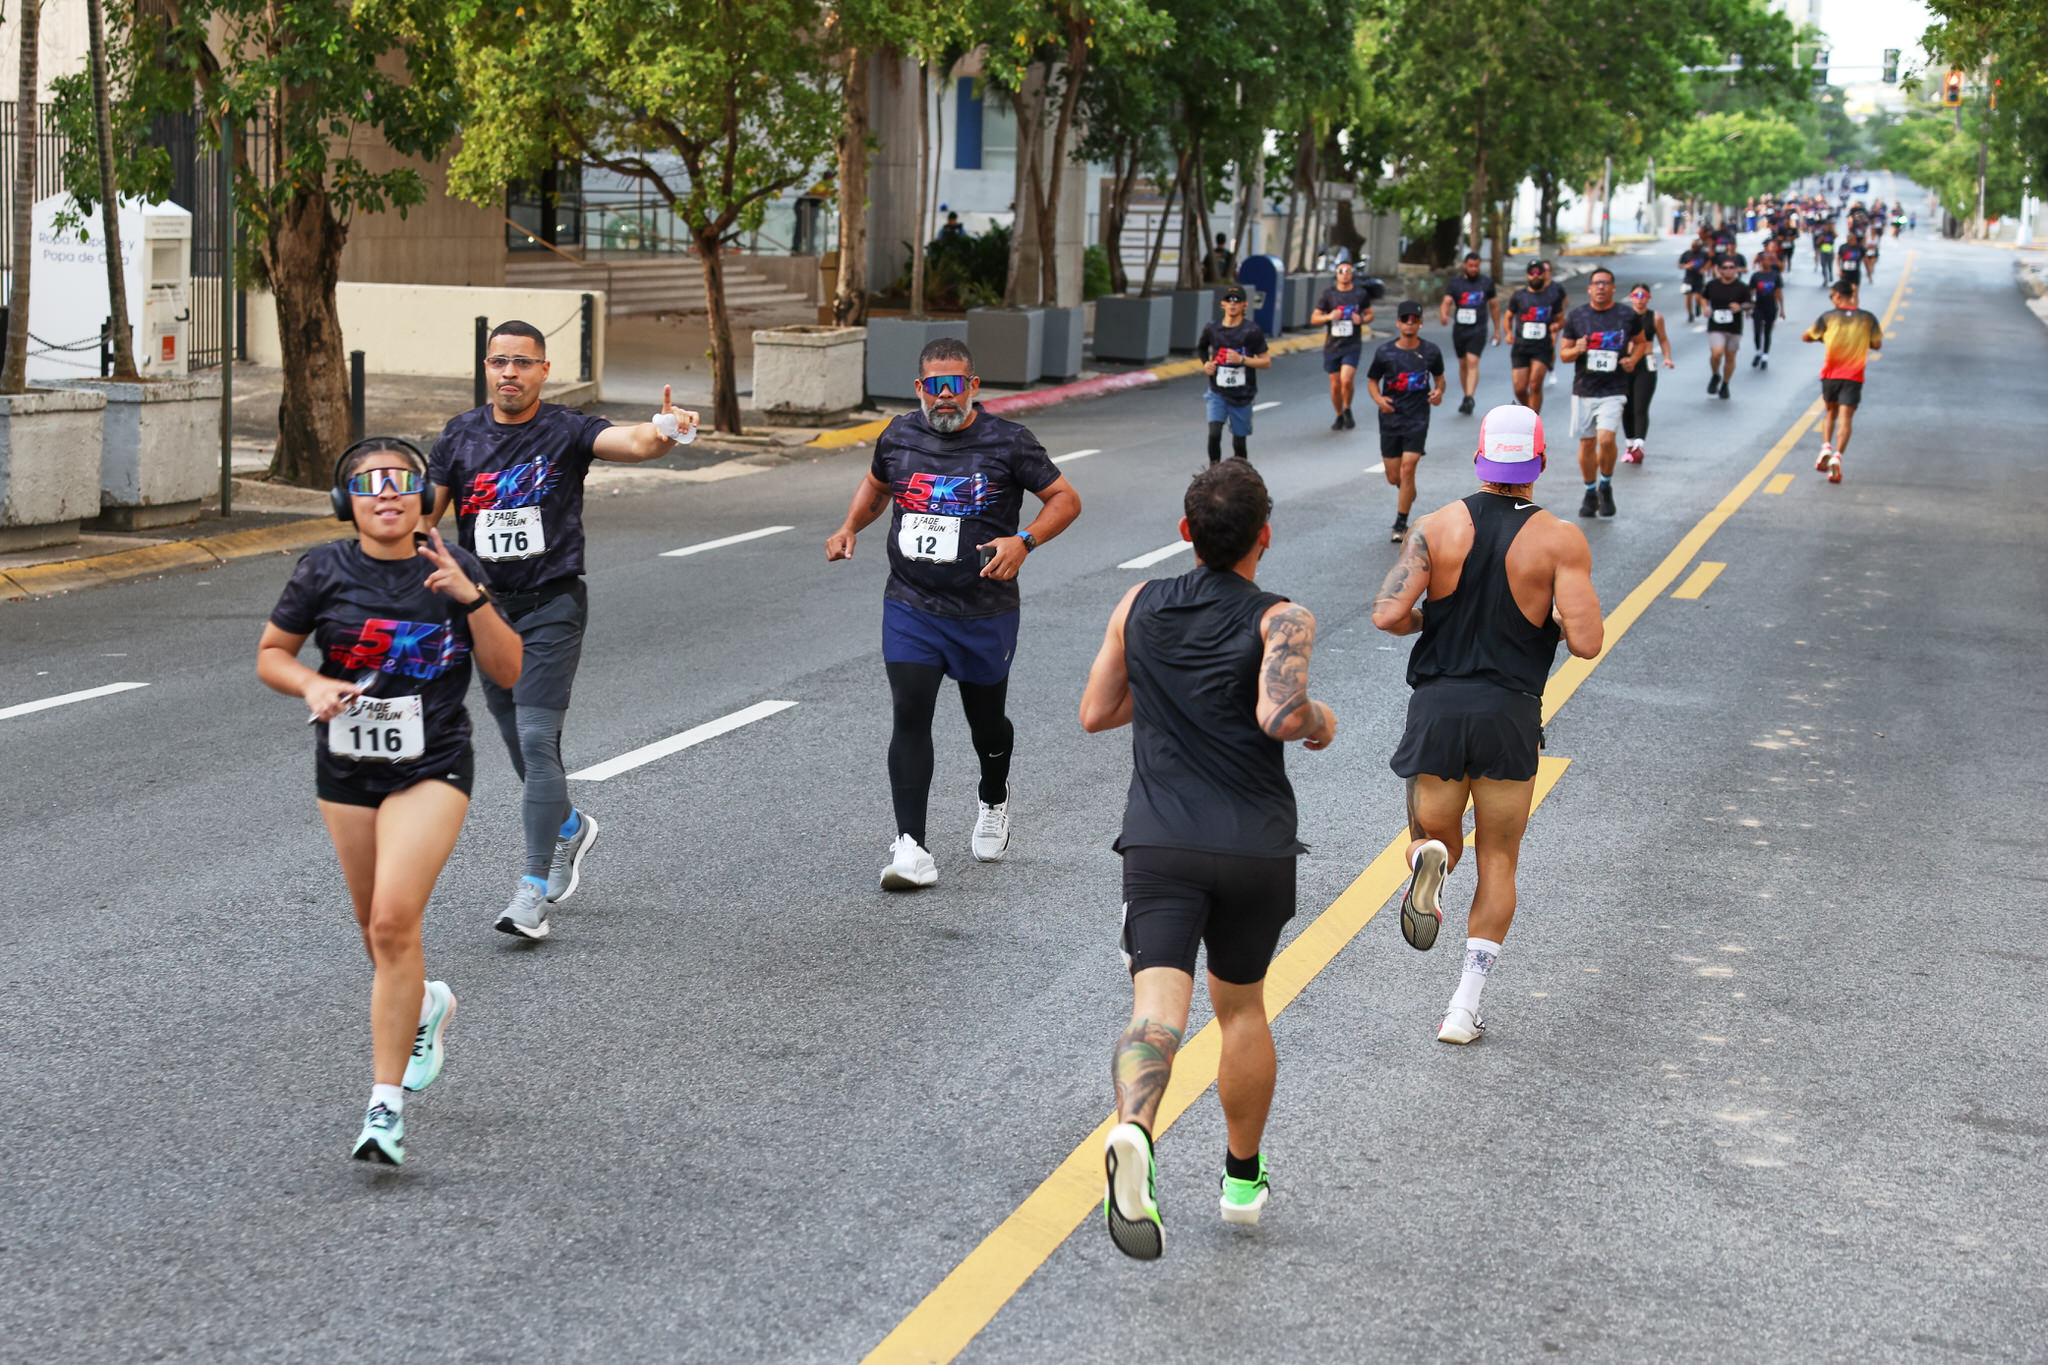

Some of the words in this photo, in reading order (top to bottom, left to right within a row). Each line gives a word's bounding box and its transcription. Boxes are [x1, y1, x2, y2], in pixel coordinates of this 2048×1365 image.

[78, 252, 94, 263] de
[98, 252, 129, 265] Ca
[469, 463, 531, 503] 5K
[905, 472, 971, 502] 5K
[494, 511, 518, 520] FADE
[507, 518, 527, 527] RUN
[919, 516, 940, 525] FADE
[488, 531, 528, 553] 176
[915, 535, 937, 555] 12
[351, 618, 441, 659] 5K
[358, 700, 392, 713] FADE
[375, 711, 404, 721] RUN
[349, 725, 403, 752] 116
